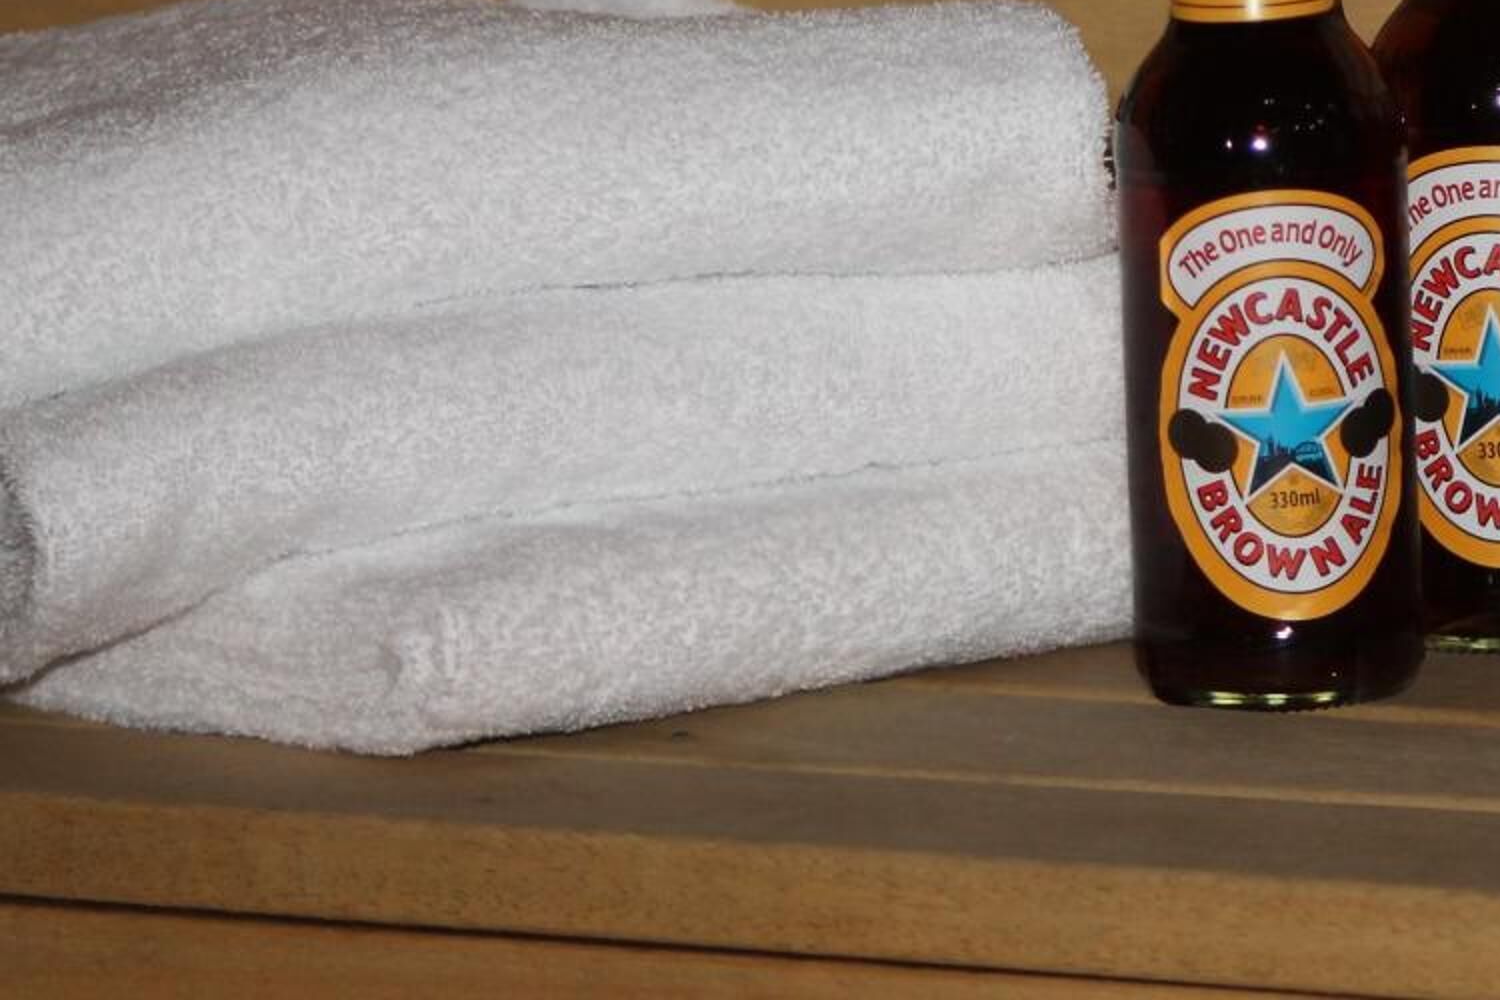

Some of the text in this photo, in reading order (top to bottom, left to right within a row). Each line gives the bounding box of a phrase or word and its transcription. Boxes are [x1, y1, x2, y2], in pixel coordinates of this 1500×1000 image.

[1408, 196, 1432, 231] he
[1430, 181, 1475, 208] One
[1179, 220, 1363, 279] The One and Only
[1188, 288, 1375, 402] NEWCASTLE
[1197, 463, 1384, 580] BROWN ALE
[1269, 488, 1321, 510] 330ml
